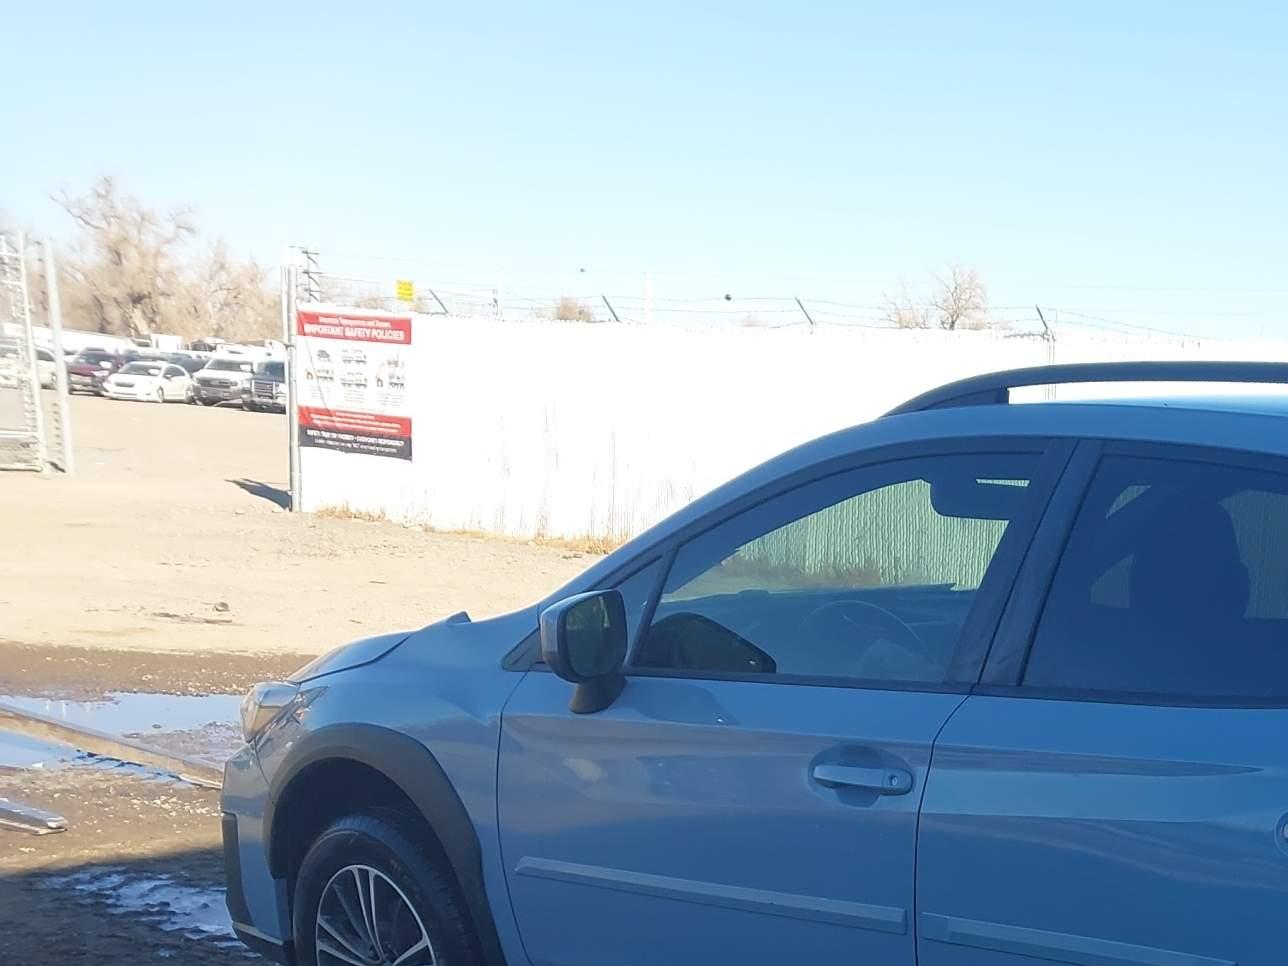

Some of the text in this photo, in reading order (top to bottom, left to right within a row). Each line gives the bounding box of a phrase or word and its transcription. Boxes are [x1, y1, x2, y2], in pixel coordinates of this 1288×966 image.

[304, 323, 405, 341] IMPORTANT SAFETY POLICIES
